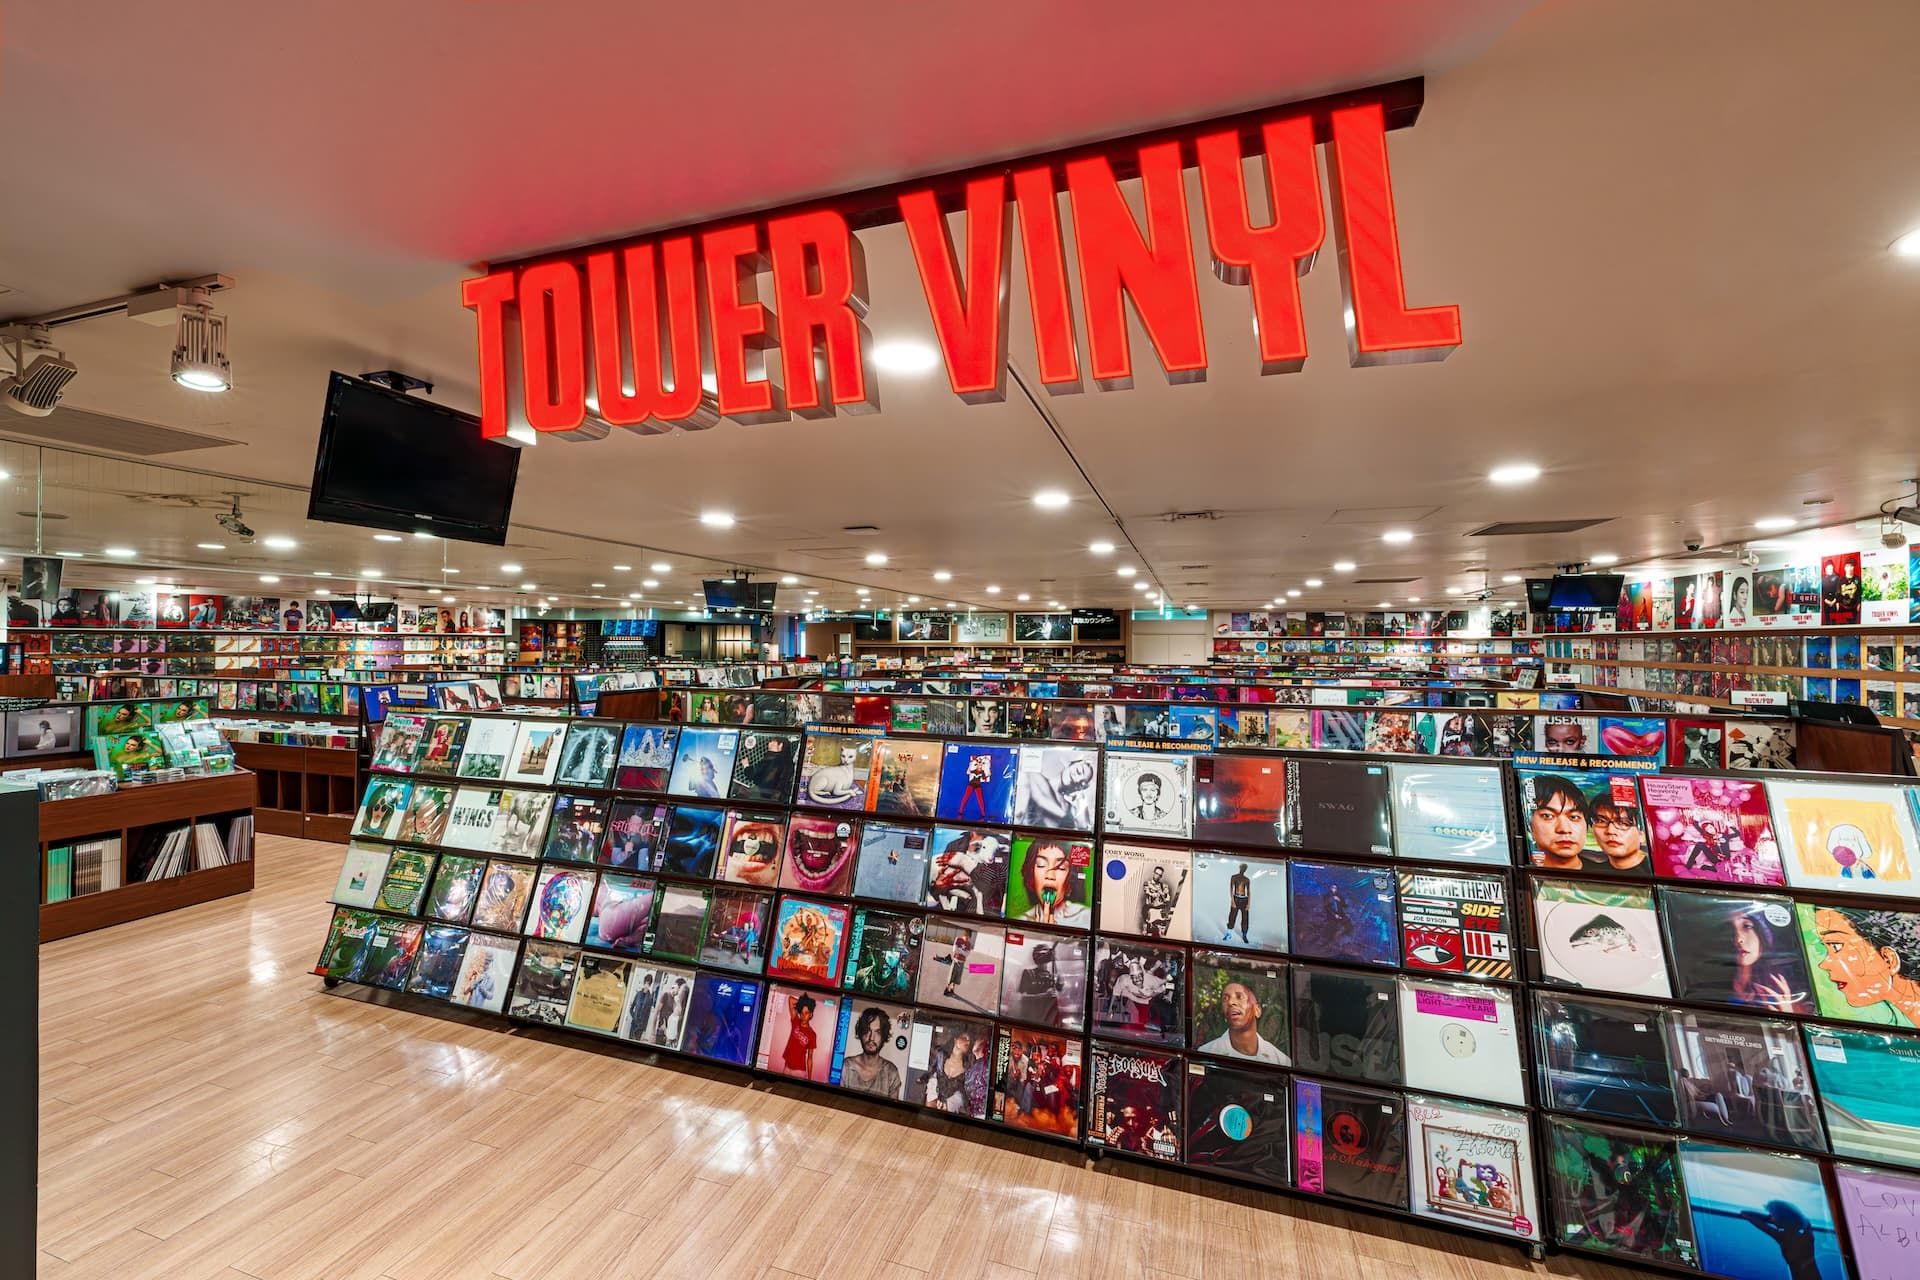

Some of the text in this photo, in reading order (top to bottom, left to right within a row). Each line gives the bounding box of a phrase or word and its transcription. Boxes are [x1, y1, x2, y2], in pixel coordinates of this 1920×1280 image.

[461, 103, 1463, 440] TOWER VINYL
[1126, 740, 1154, 749] RELEASE
[1162, 742, 1212, 752] RECOMMENDS
[1515, 756, 1657, 770] NEW RELEASE & RECOMMENDS
[452, 806, 493, 828] WINGS
[1440, 881, 1501, 900] METHENY
